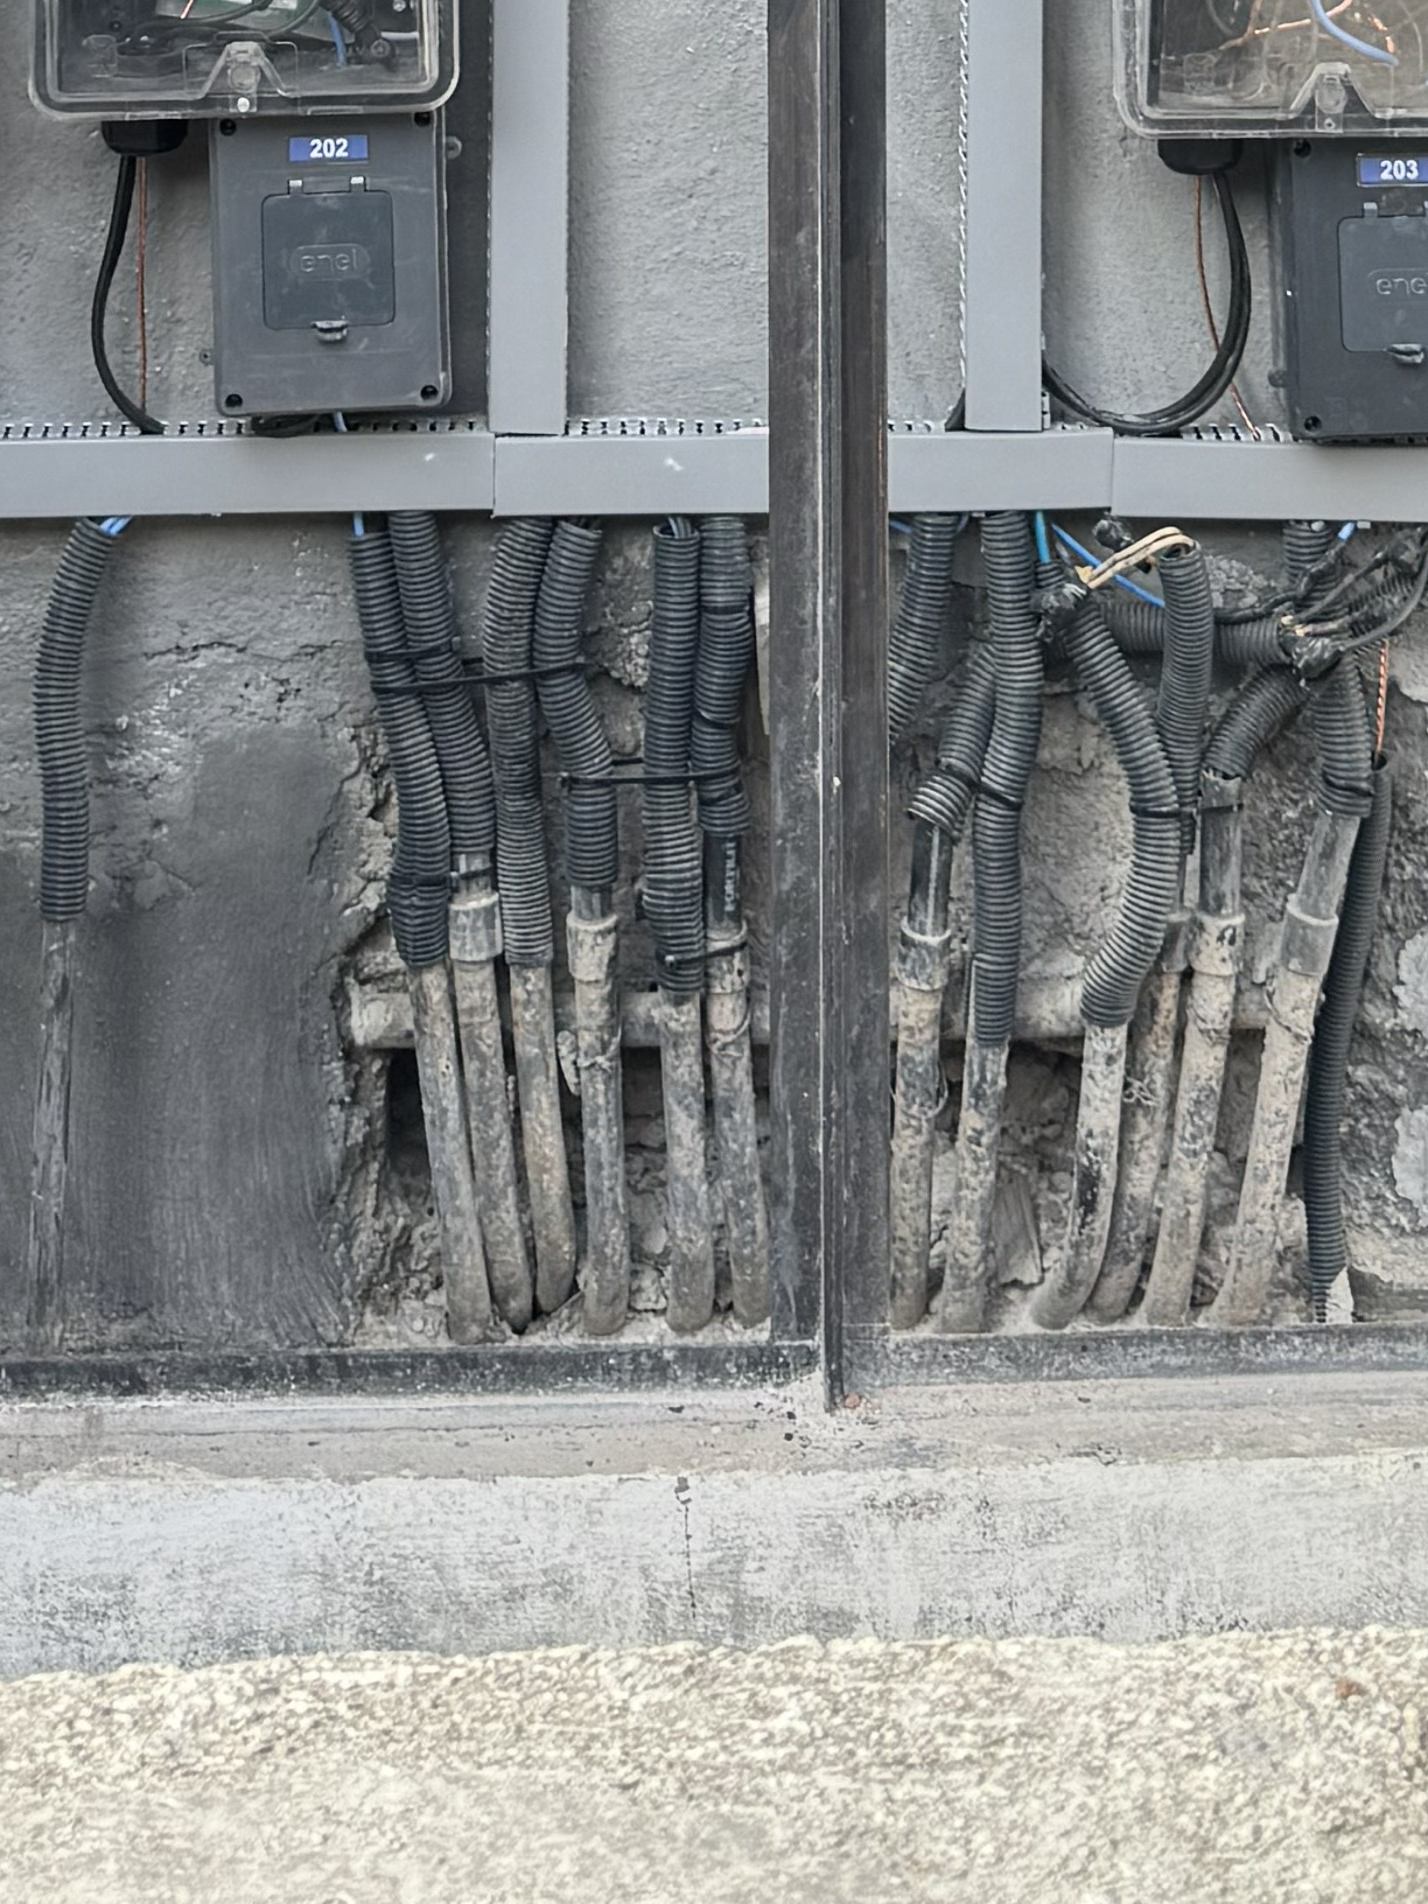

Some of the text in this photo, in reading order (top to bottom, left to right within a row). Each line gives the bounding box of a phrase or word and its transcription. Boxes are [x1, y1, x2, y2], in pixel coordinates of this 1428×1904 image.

[309, 137, 349, 159] 202
[1379, 159, 1419, 181] 203
[299, 248, 358, 273] enel
